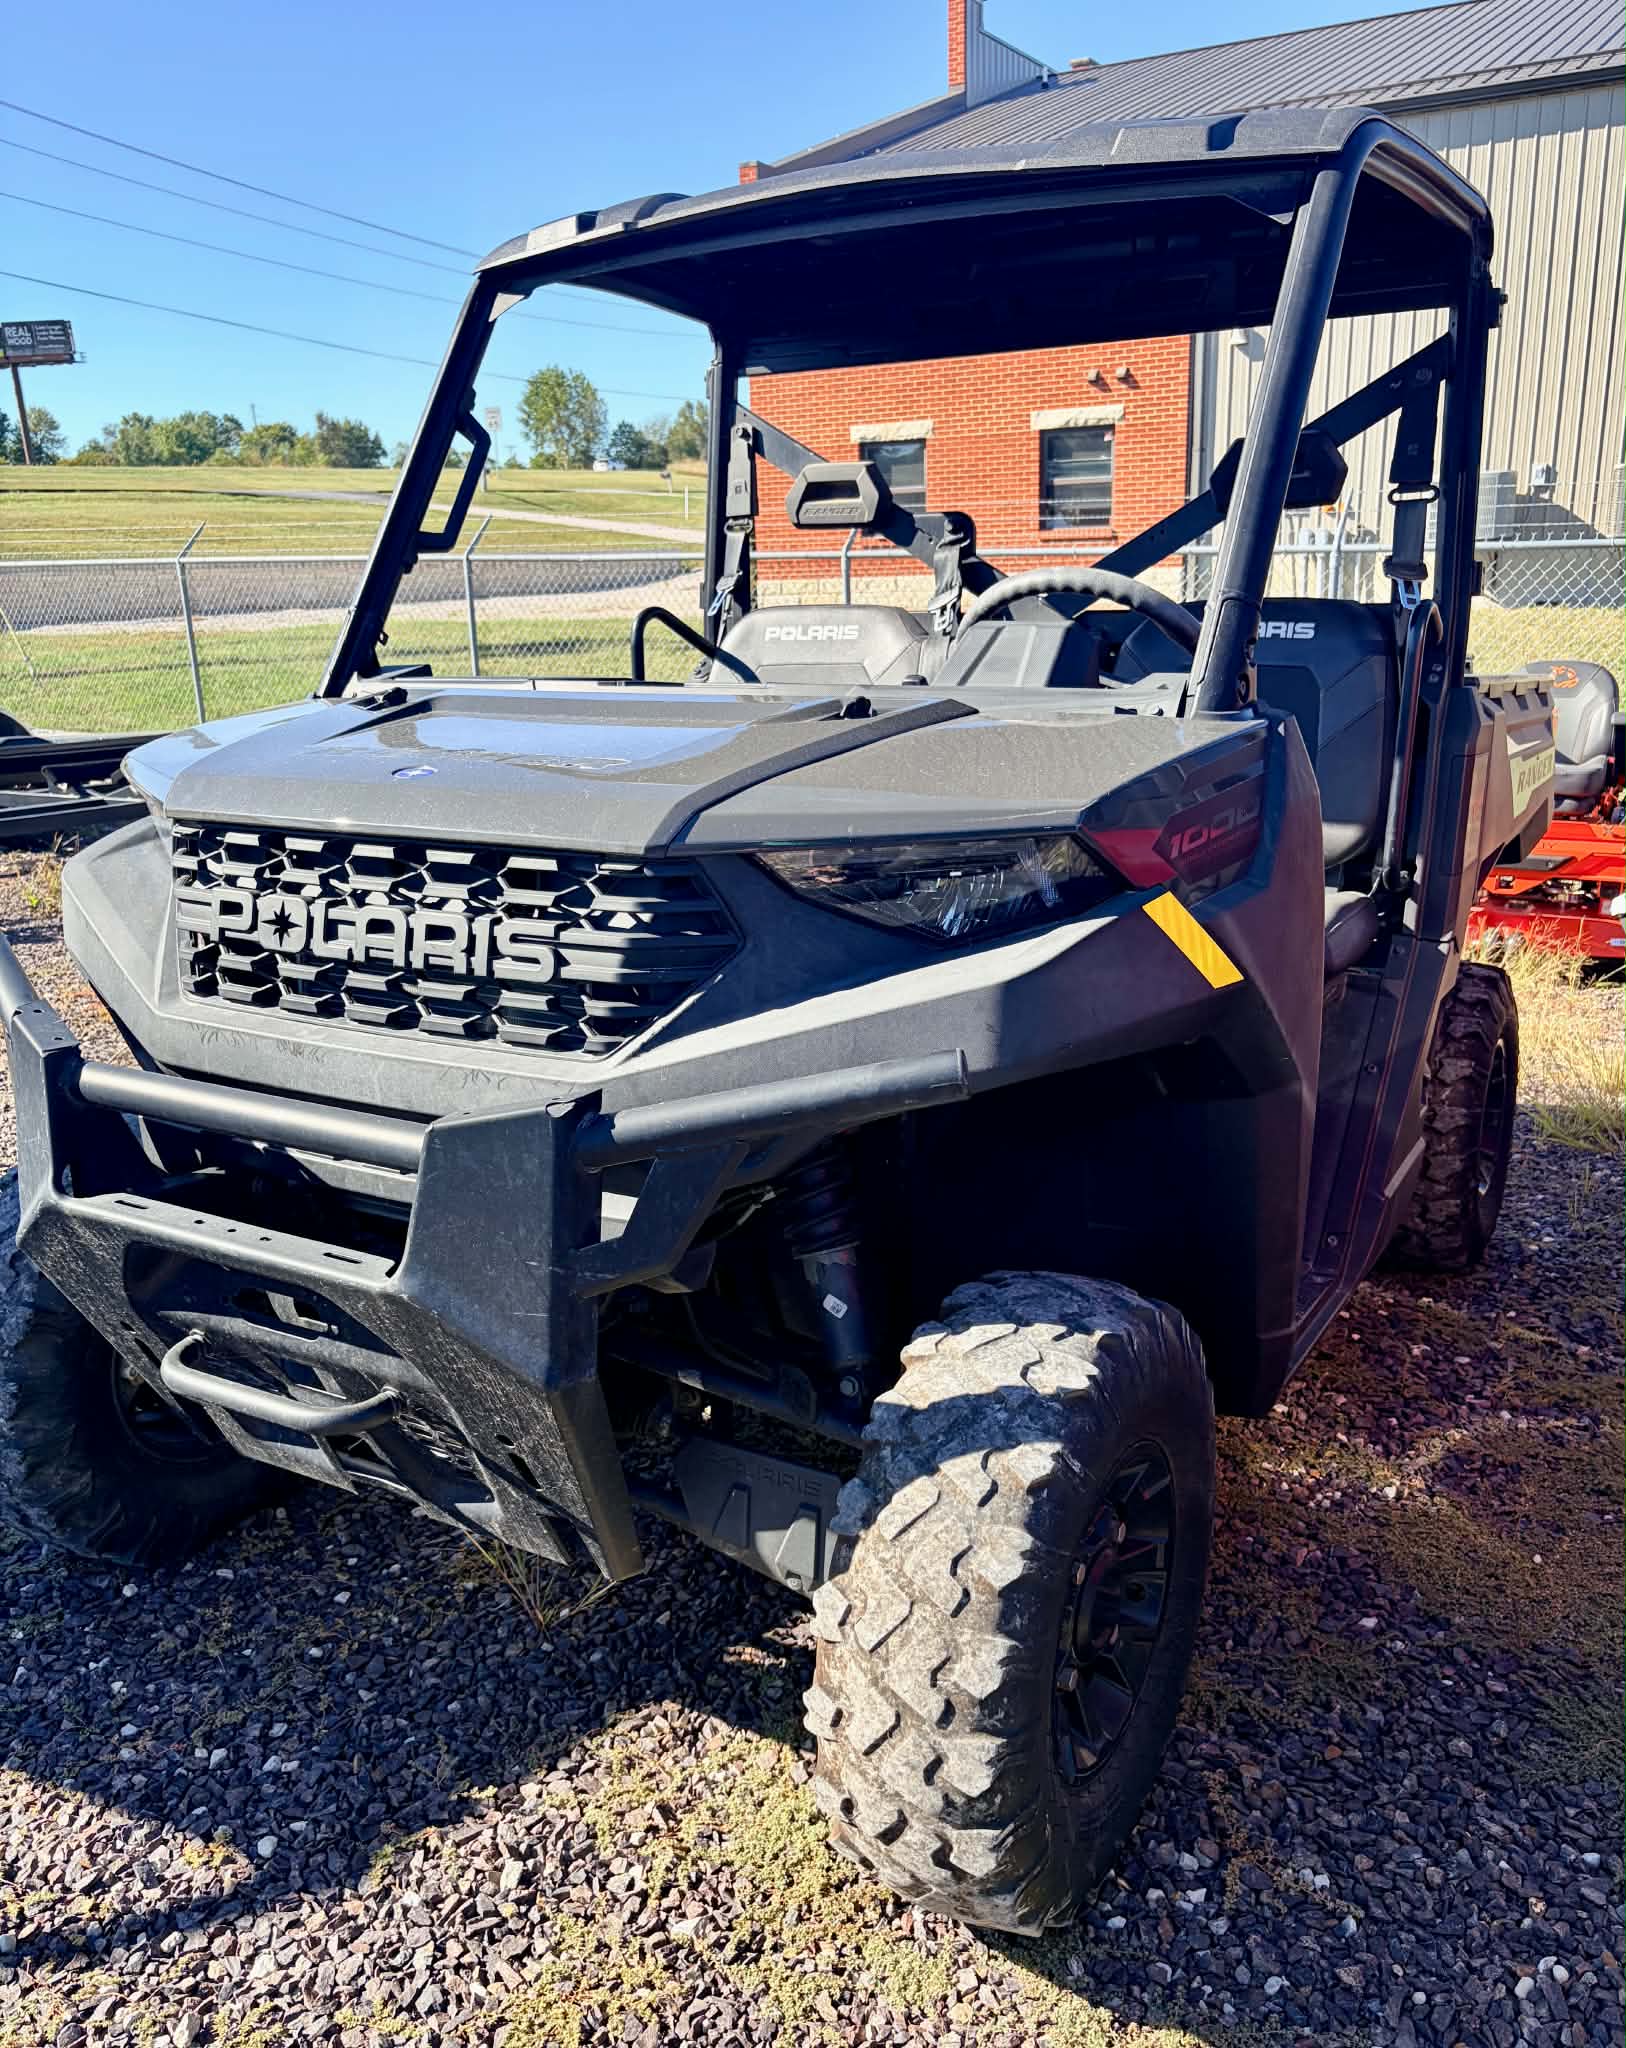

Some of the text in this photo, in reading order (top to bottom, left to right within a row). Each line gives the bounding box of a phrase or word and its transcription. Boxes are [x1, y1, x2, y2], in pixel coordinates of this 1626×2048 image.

[5, 326, 31, 337] REAL
[7, 337, 33, 346] WOOD
[764, 624, 859, 641] POLARIS
[209, 886, 558, 984] POLARIS
